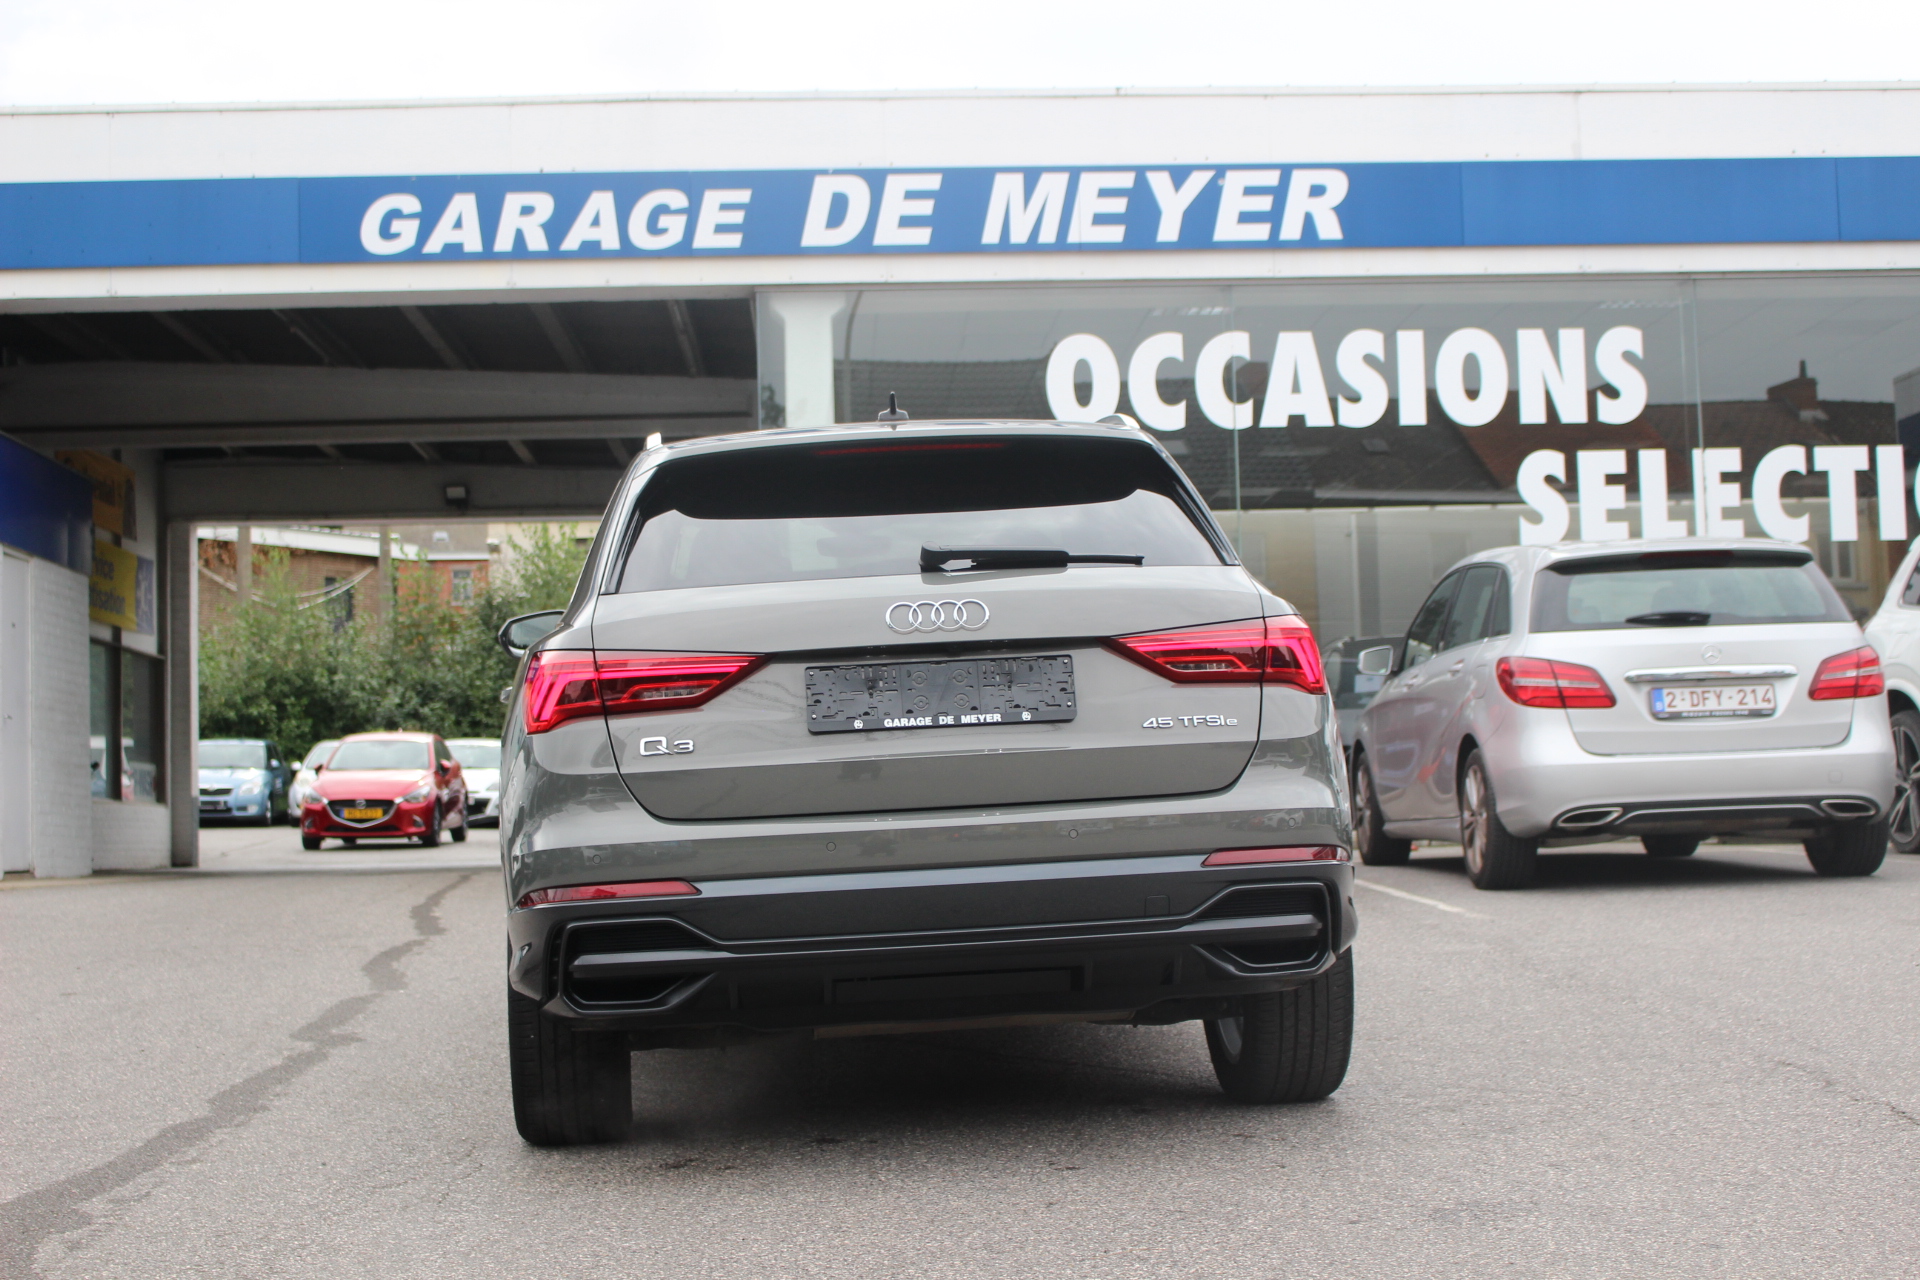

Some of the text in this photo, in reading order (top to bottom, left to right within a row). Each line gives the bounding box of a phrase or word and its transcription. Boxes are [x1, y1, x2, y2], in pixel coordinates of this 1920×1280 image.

[360, 168, 1349, 255] GARAGE DE MEYER
[1046, 325, 1648, 431] OCCASIONS
[1516, 444, 1920, 546] SELECTI
[639, 736, 694, 756] Q3
[884, 713, 1002, 728] GARAGE DE MEYER
[1142, 717, 1174, 729] 45
